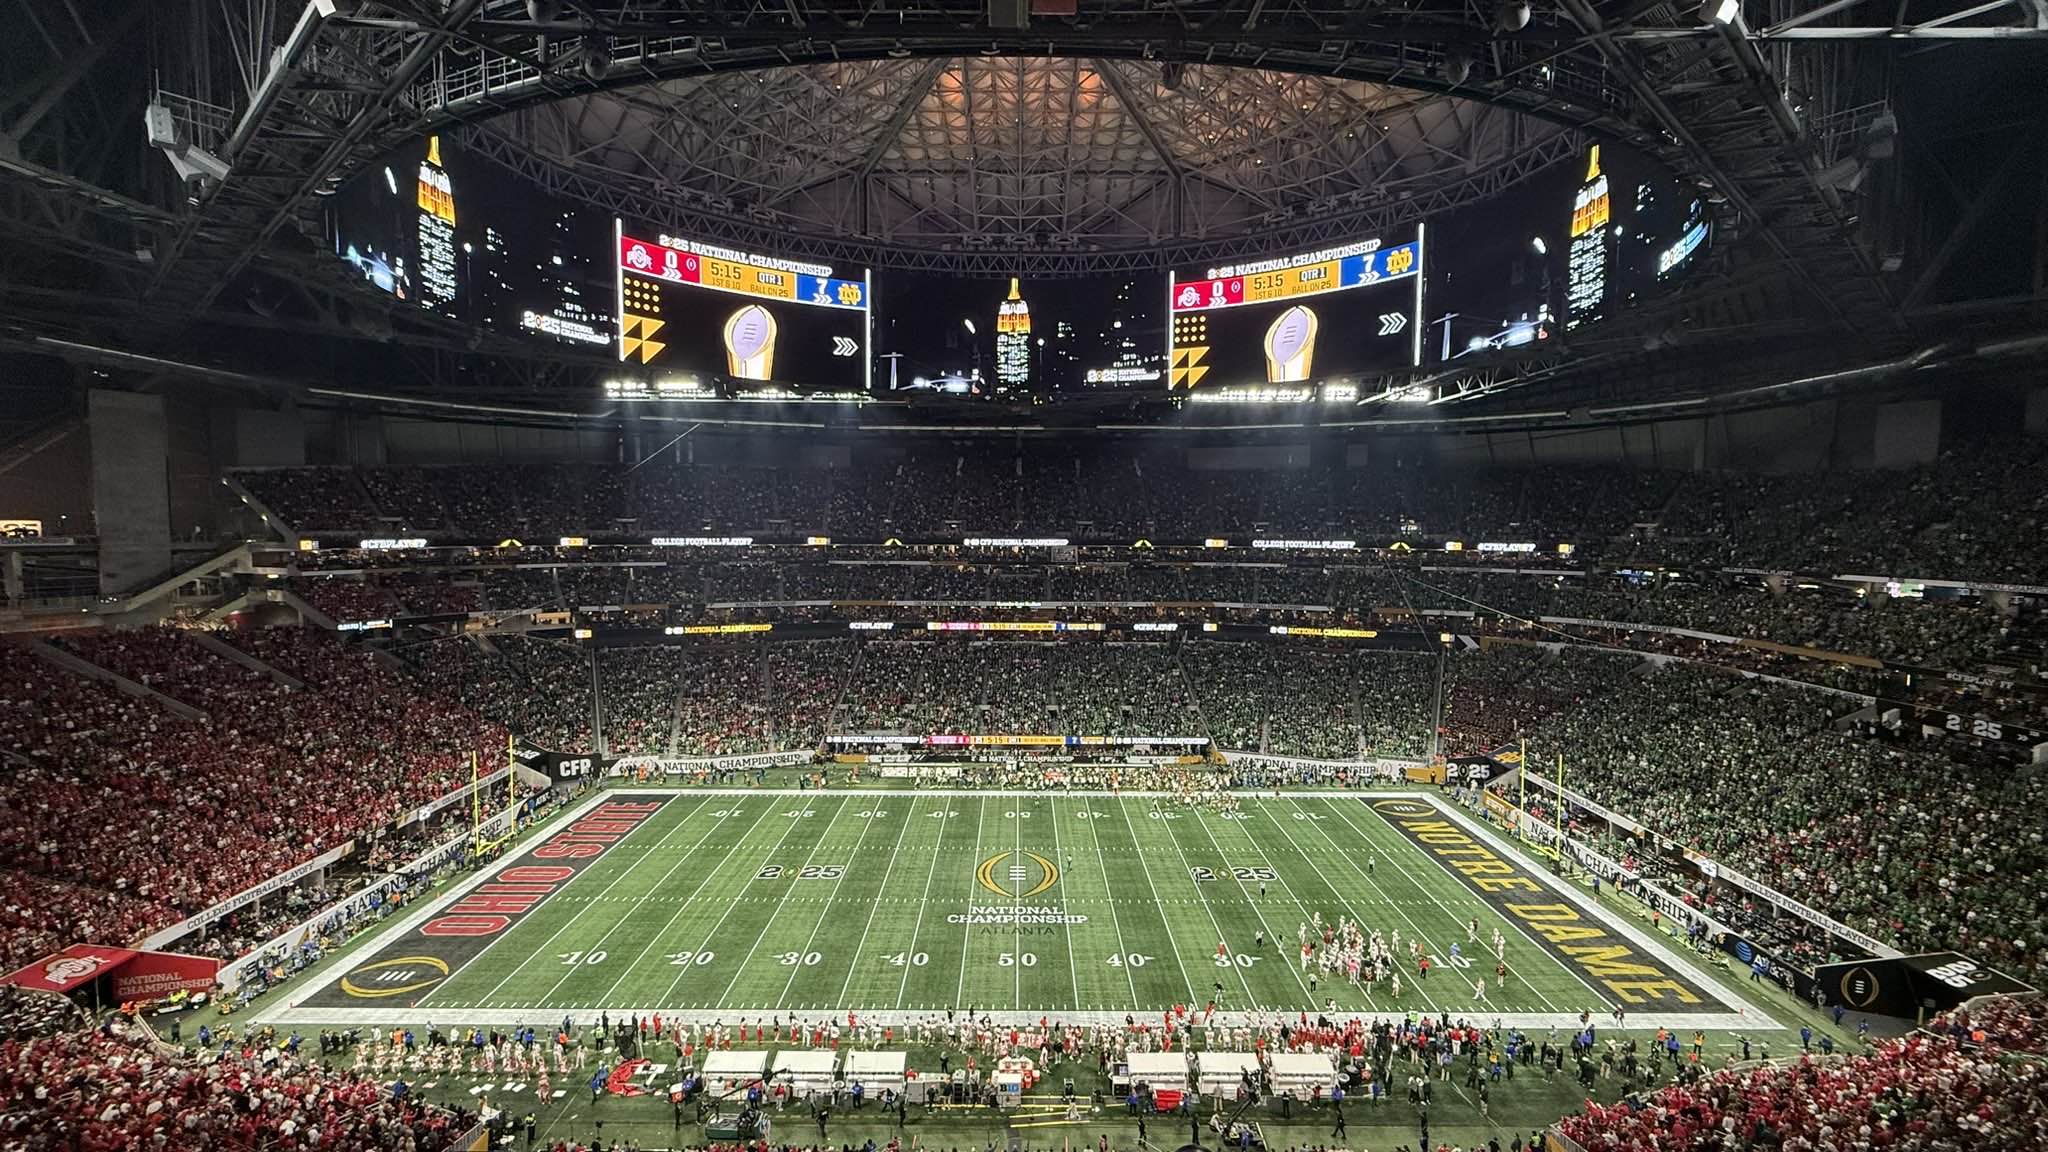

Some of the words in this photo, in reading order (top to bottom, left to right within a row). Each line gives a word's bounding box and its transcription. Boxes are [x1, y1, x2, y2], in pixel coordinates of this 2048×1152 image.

[666, 251, 677, 269] 0
[690, 241, 749, 265] NATIONAL
[750, 254, 832, 278] CHAMPIONSHIP
[1236, 258, 1291, 276] NATIONAL
[1292, 238, 1382, 266] CHAMPIONSHIP
[1363, 255, 1375, 272] 7
[711, 262, 742, 280] 5:15
[758, 272, 776, 284] QTR
[1300, 269, 1318, 282] QTR
[712, 278, 725, 288] 1ST
[732, 281, 740, 290] 10
[816, 279, 828, 294] 7
[1212, 281, 1223, 297] 0
[1254, 274, 1283, 290] 5:15
[1321, 280, 1332, 289] 25
[778, 287, 788, 297] 25
[524, 311, 560, 334] 2025
[1087, 369, 1117, 382] 2025
[1288, 627, 1322, 636] NATIONAL
[560, 758, 591, 776] CFP
[1446, 763, 1490, 778] 2025
[420, 866, 576, 936] OHIO
[532, 802, 663, 858] STATE
[187, 902, 231, 929] COLLEGE
[232, 880, 279, 910] FOOTBALL
[972, 906, 1065, 915] NATIONAL
[947, 914, 1088, 924] CHAMPIONSHIP
[1400, 820, 1543, 892] NOTRE
[1504, 903, 1704, 1004] DAME
[1744, 880, 1781, 904] COLLEGE
[1782, 900, 1832, 928] FOOTBALL
[1831, 924, 1878, 950] PLAYOFF
[981, 926, 1055, 936] ATLANTA
[561, 951, 607, 965] 10
[668, 952, 714, 965] 20
[780, 952, 822, 966] 30
[889, 952, 929, 966] 40
[998, 952, 1037, 966] 50
[1106, 954, 1145, 967] 40
[120, 972, 182, 986] NATIONAL
[119, 978, 213, 996] CHAMPIONSHIP
